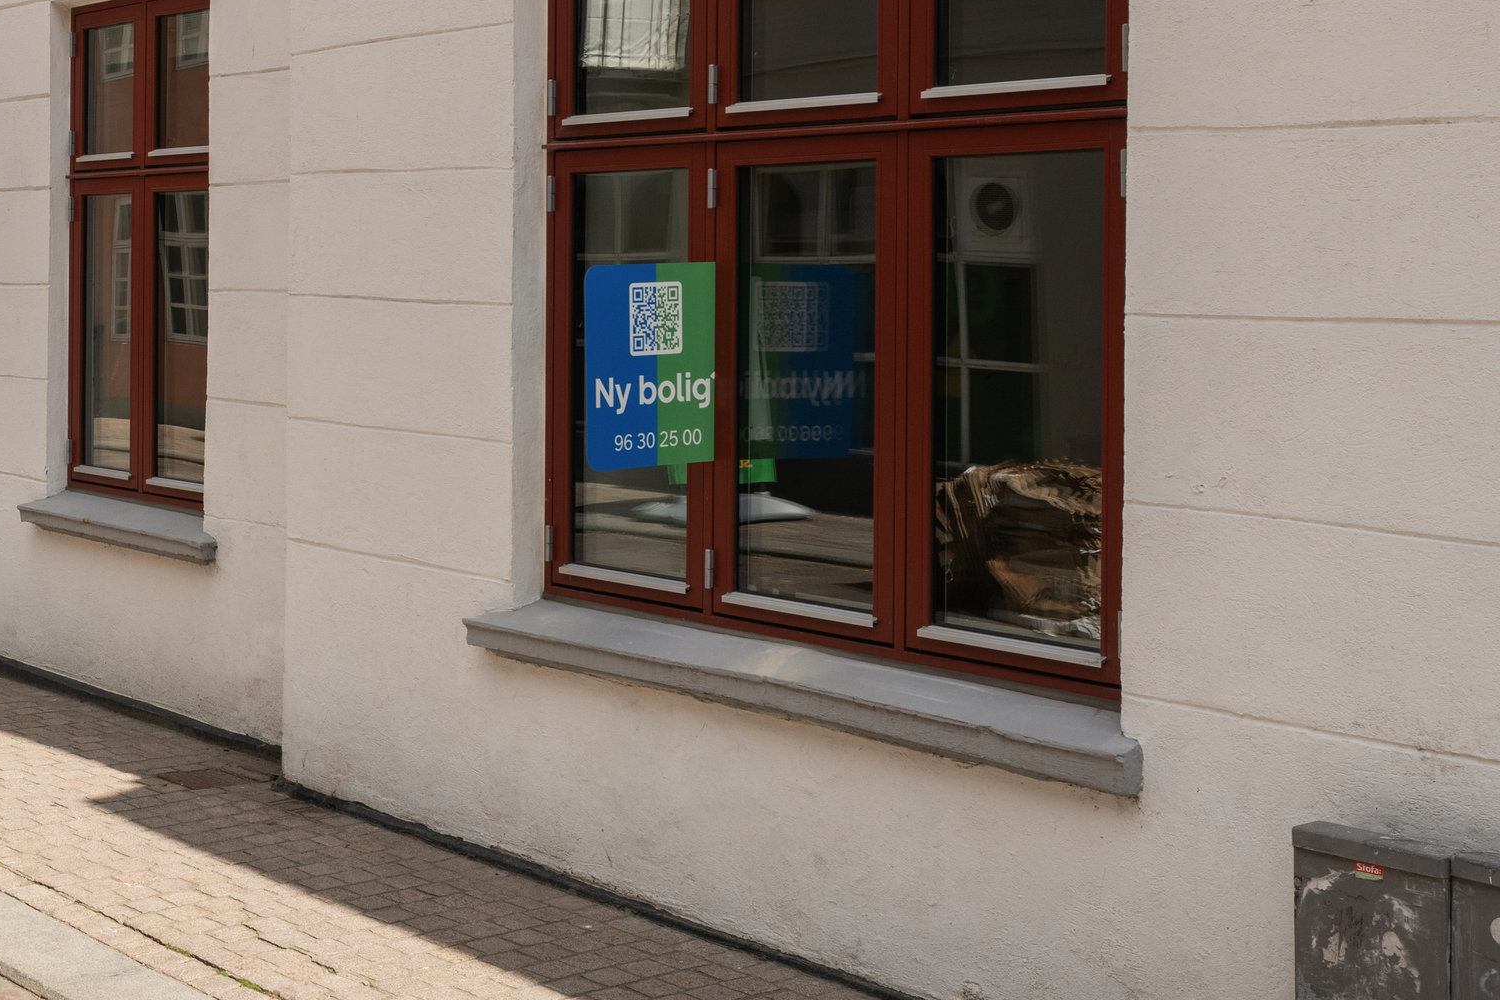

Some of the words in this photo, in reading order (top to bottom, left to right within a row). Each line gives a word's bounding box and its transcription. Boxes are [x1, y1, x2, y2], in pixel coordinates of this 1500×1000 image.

[595, 377, 632, 415] Ny
[638, 371, 715, 409] bolig
[614, 433, 633, 452] 96
[637, 431, 656, 449] 30
[659, 430, 679, 448] 25
[682, 428, 702, 446] 00
